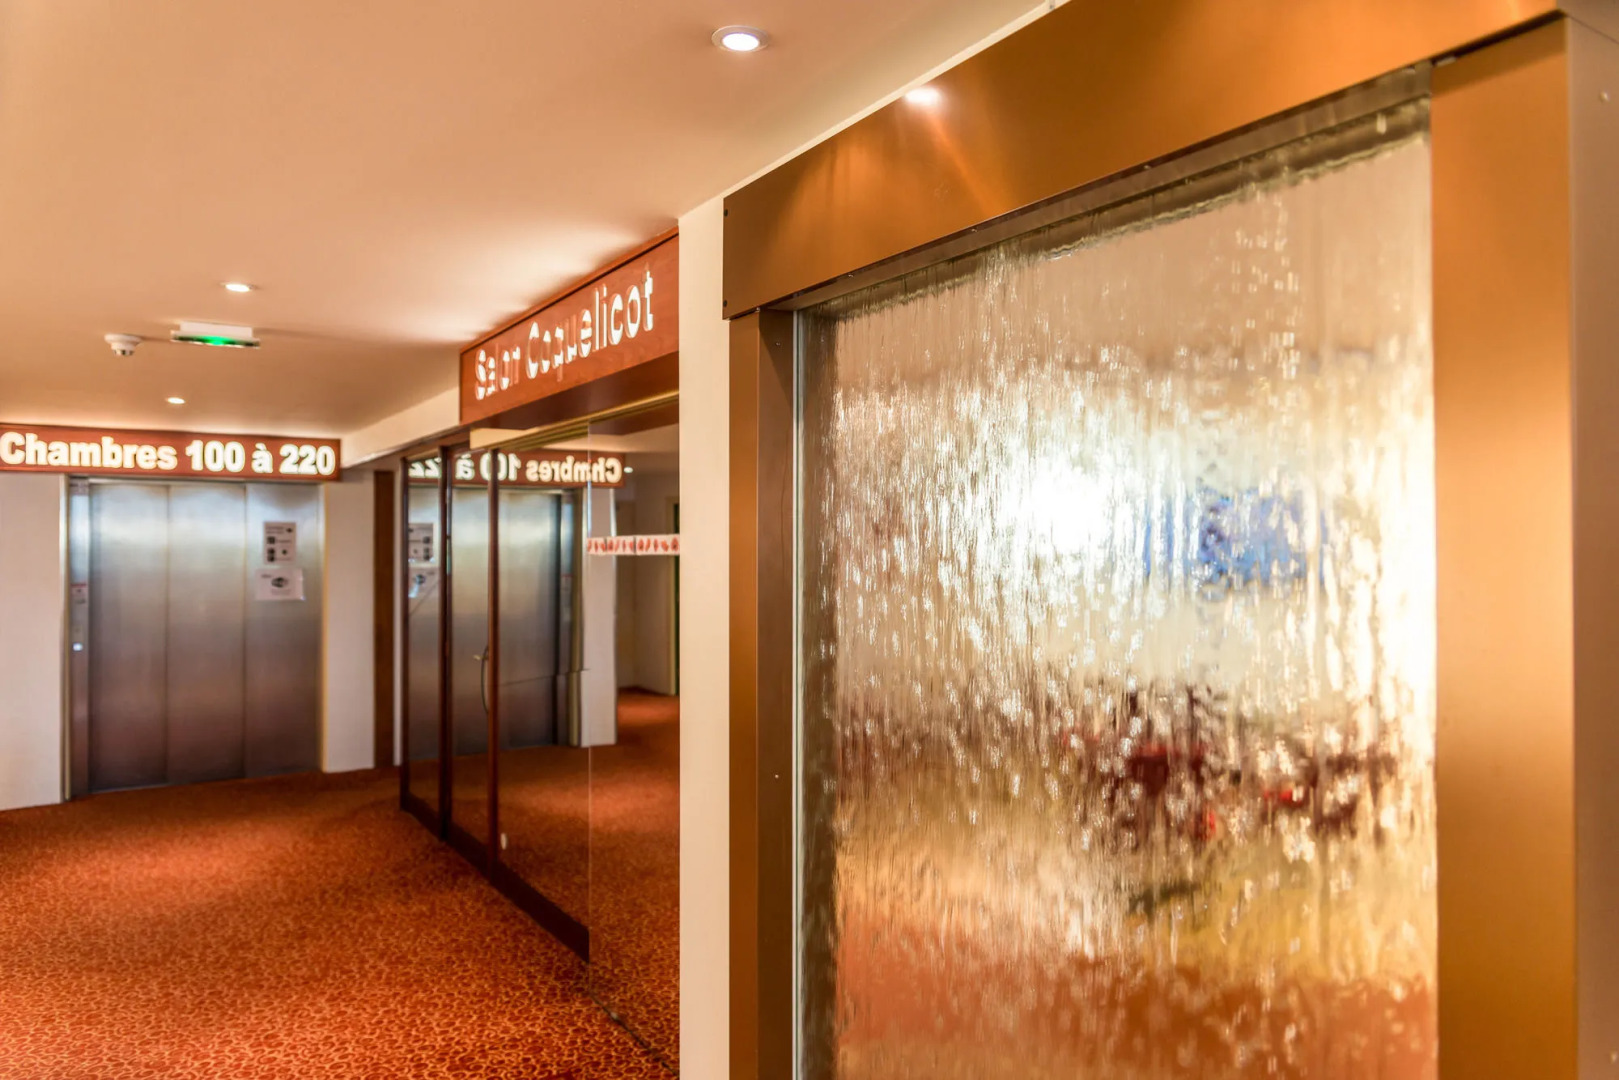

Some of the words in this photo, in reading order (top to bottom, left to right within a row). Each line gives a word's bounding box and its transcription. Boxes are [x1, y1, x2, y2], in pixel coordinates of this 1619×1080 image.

[526, 266, 654, 382] Coquelicot
[0, 431, 178, 471] Chambres
[185, 439, 246, 473] 100
[251, 442, 273, 474] à
[279, 444, 336, 476] 220
